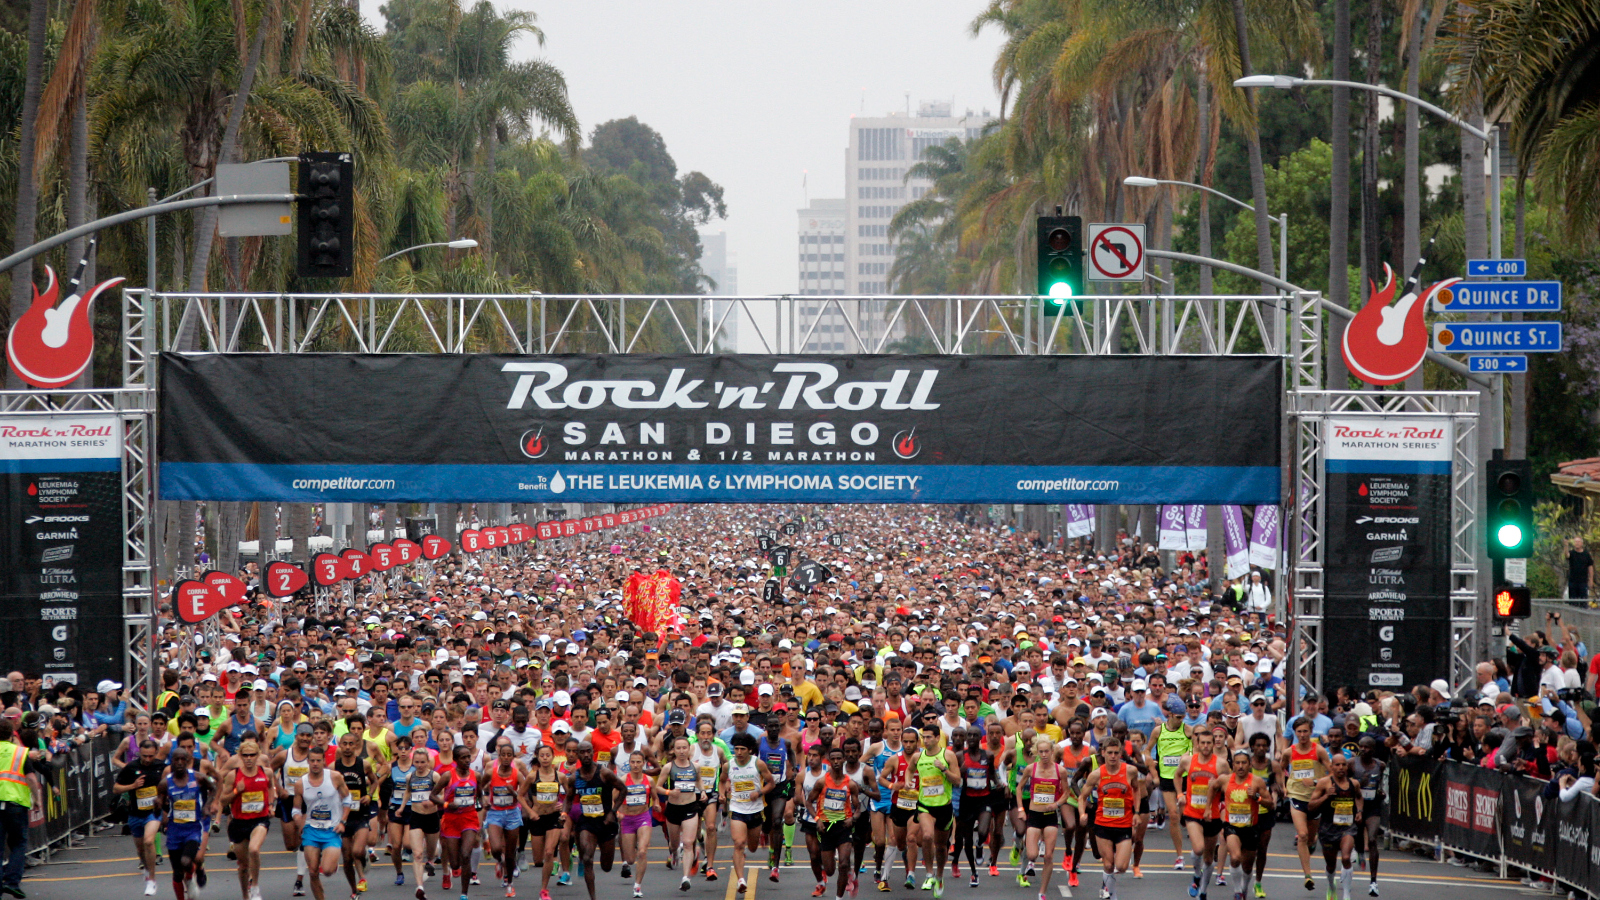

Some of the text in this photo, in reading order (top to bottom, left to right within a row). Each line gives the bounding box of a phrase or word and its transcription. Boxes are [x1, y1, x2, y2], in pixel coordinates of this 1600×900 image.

[1496, 262, 1518, 274] 600
[1478, 358, 1498, 370] 500
[562, 422, 880, 445] SAN DIEGO
[565, 448, 876, 461] MARATHON & 1/2 MARATHON
[292, 476, 396, 492] competitor.com
[567, 474, 919, 490] THE LEUKEMIA & LYMPHOMA SOCIETY
[1016, 478, 1119, 493] competitor.com
[566, 526, 574, 534] 15
[470, 538, 477, 548] 8
[488, 535, 495, 545] 9
[762, 541, 767, 549] 8
[401, 548, 409, 560] 6
[432, 544, 439, 555] 7
[381, 553, 389, 566] 5
[778, 556, 783, 565] 6
[326, 565, 335, 579] 3
[352, 560, 360, 573] 4
[40, 575, 76, 583] ULTRA
[806, 569, 816, 582] 2
[1369, 576, 1405, 584] ULTRA
[280, 574, 290, 590] 2
[40, 592, 78, 600] ARROWHEAD
[766, 588, 771, 600] 3
[1368, 592, 1406, 600] ARROWHEAD
[192, 595, 205, 615] E
[41, 608, 76, 616] SPORTS
[1369, 608, 1404, 616] SPORTS
